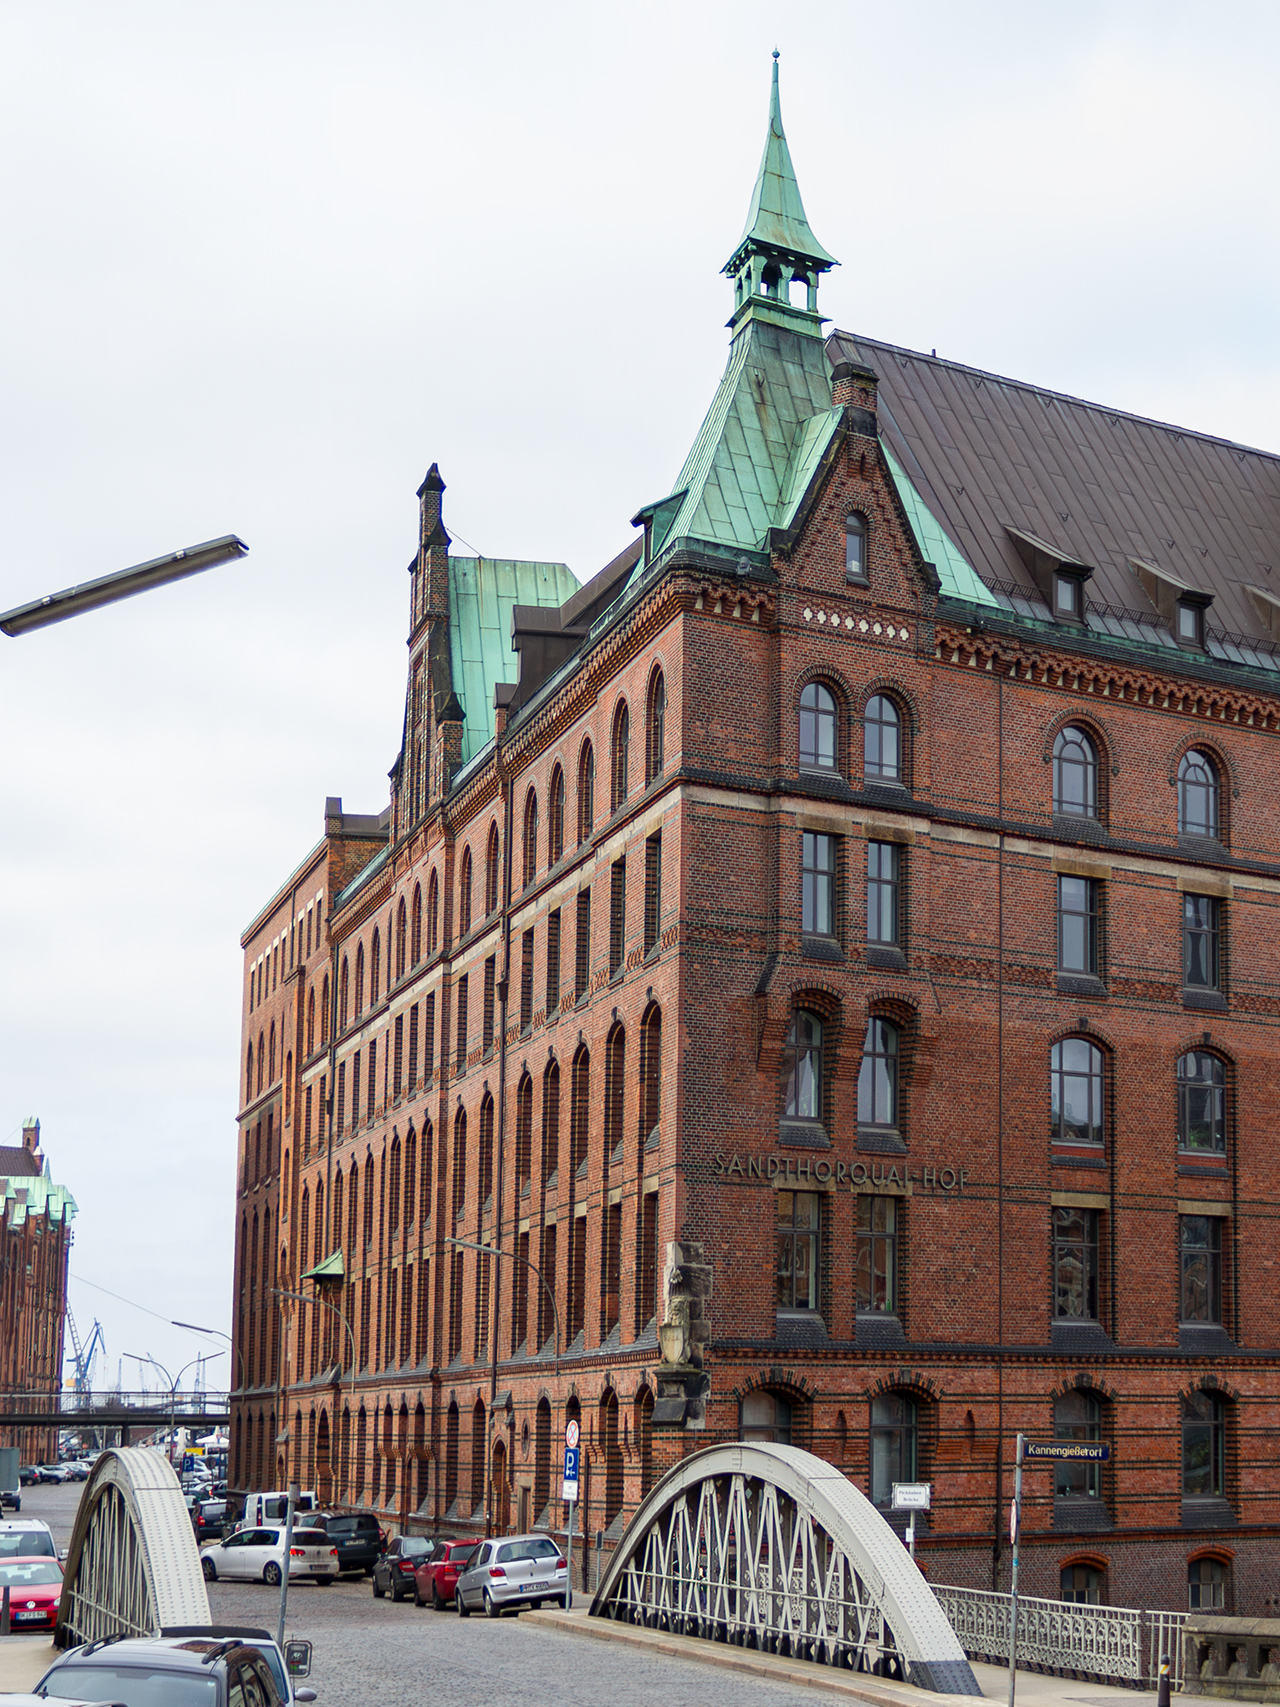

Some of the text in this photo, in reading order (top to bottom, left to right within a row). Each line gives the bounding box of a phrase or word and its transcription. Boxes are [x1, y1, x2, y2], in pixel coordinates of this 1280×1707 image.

[713, 1152, 971, 1191] SANDTHORQUAI-HOF
[1028, 1444, 1103, 1458] Kannengießerort
[184, 1458, 191, 1470] P
[566, 1452, 574, 1472] P
